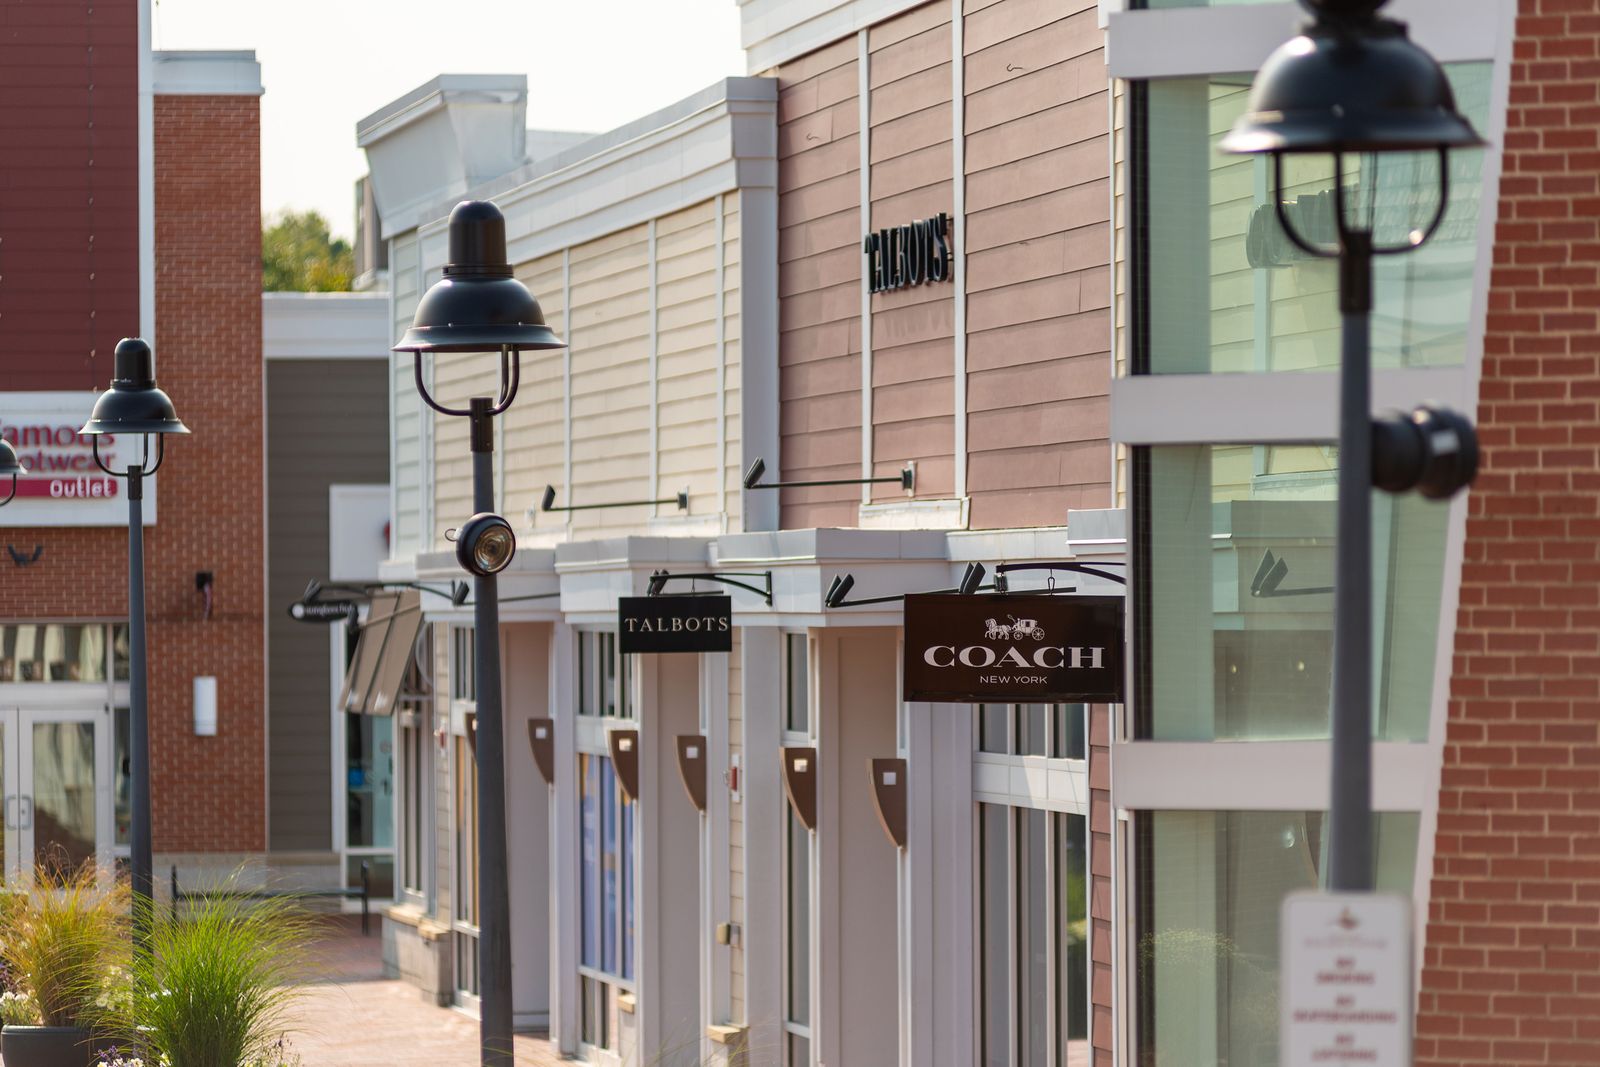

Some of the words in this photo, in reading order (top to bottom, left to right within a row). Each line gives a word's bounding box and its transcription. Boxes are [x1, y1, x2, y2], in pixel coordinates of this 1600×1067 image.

[864, 212, 947, 293] TALBOTS
[0, 420, 115, 448] amous
[19, 449, 116, 473] otwear
[50, 476, 113, 498] Outlet
[624, 617, 729, 632] TALBOTS
[924, 645, 1105, 669] COACH
[980, 675, 1010, 684] NEW
[1014, 675, 1048, 684] YORK
